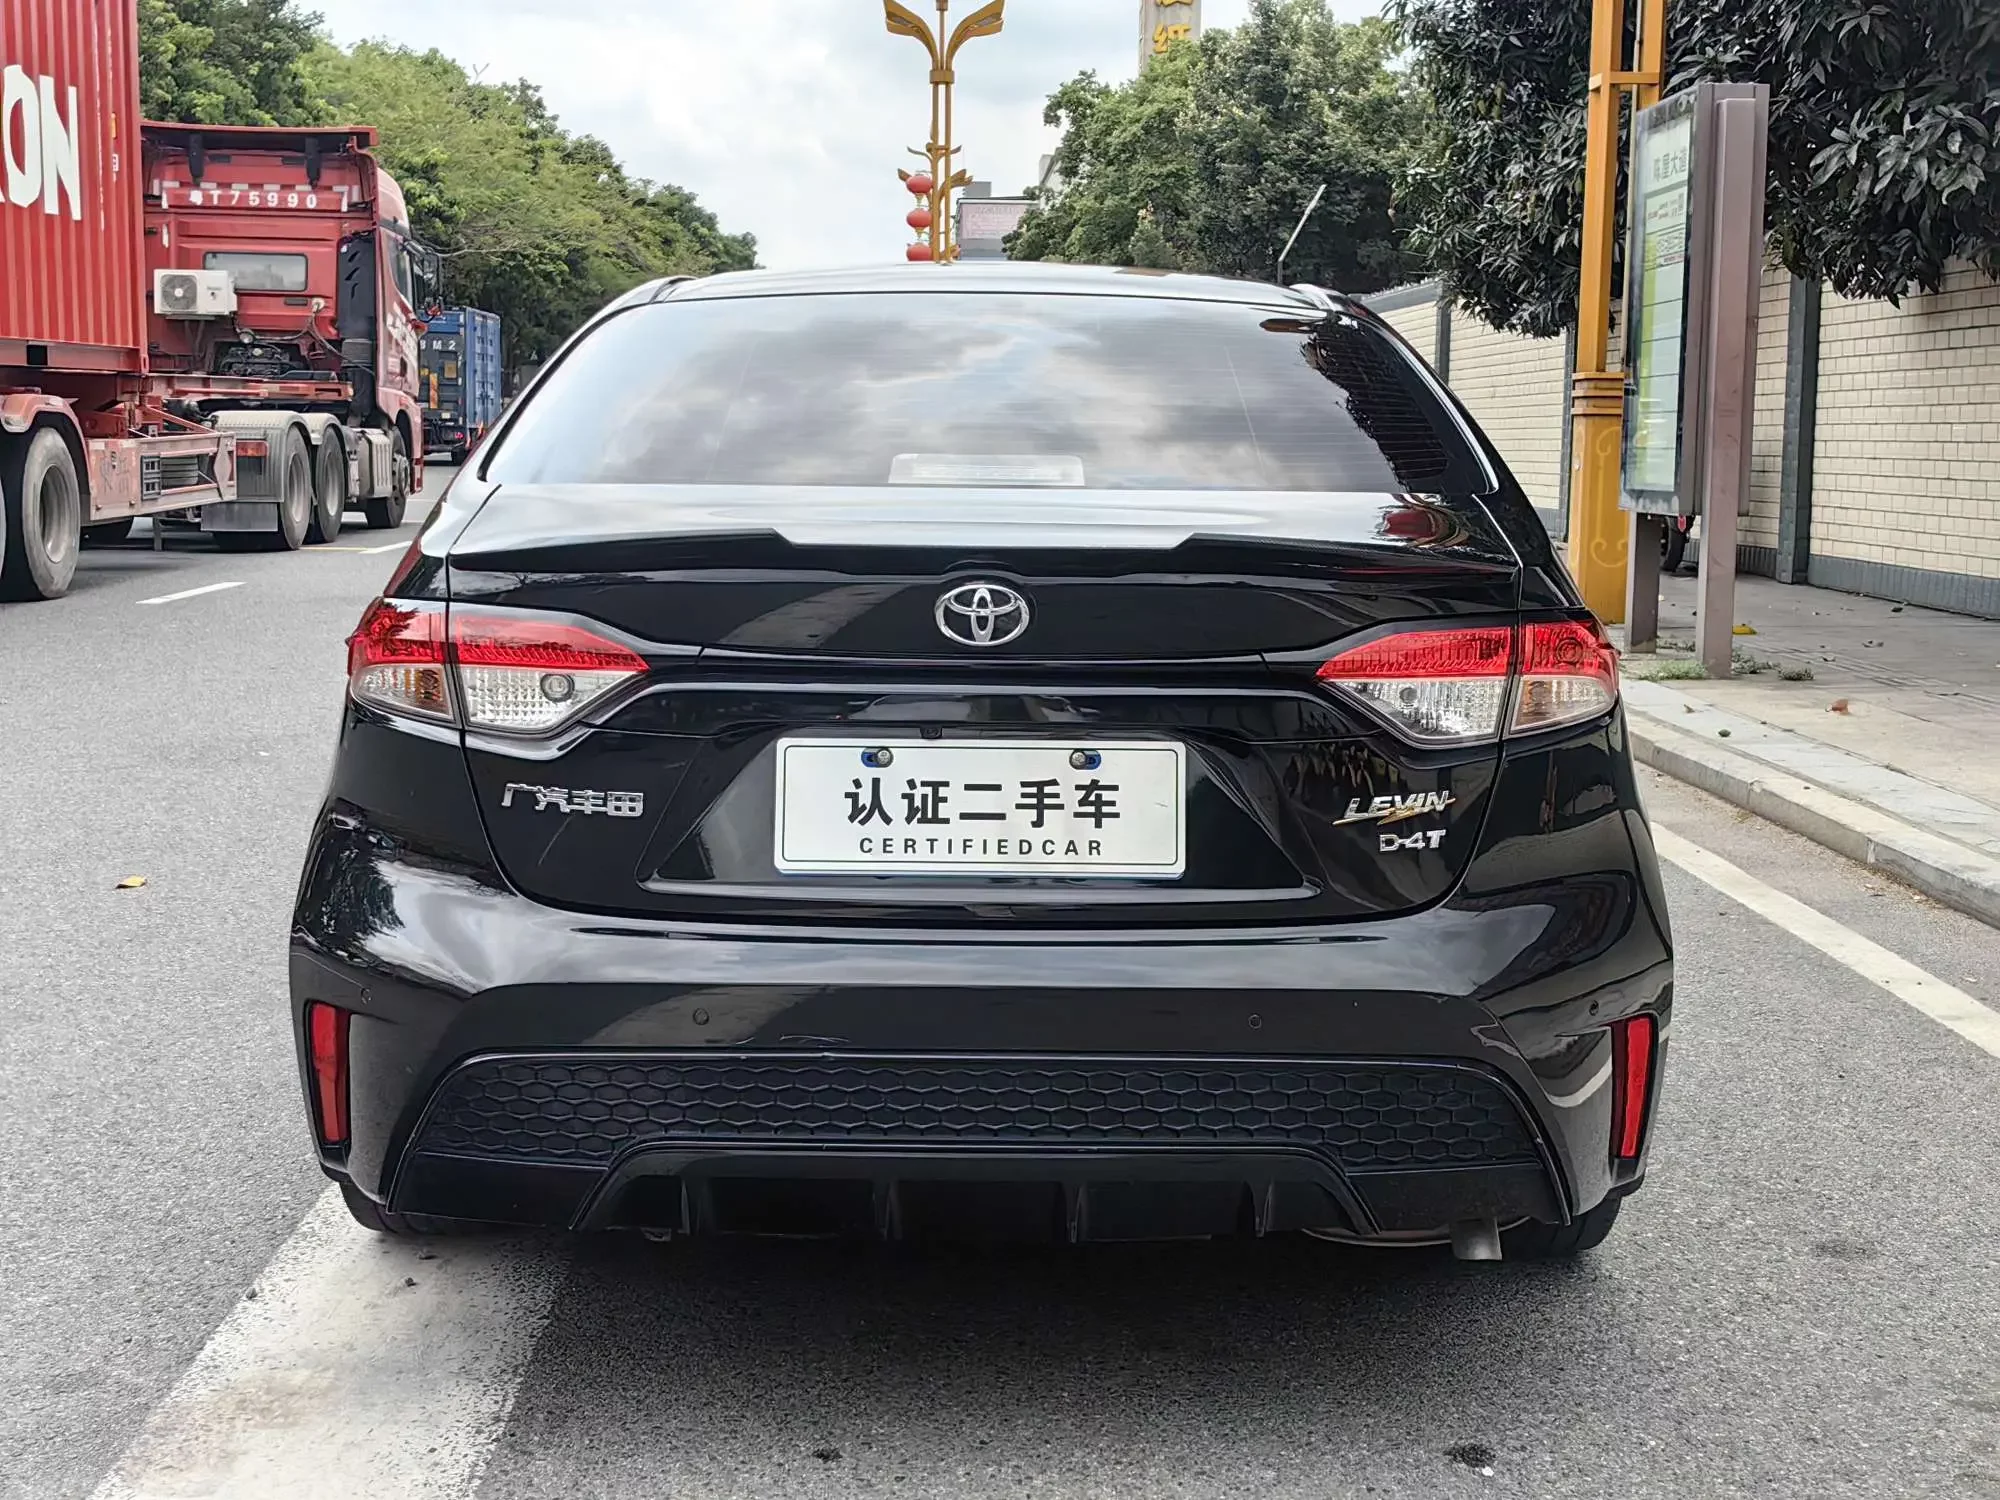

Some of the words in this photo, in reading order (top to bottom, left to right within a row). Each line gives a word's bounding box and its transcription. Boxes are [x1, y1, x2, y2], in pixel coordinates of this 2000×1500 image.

[0, 64, 82, 221] ON
[501, 783, 644, 817] 广汽丰田
[844, 777, 1121, 829] 认证二手车
[1343, 790, 1450, 819] LEVIN
[859, 837, 1102, 856] CERTIFIEDCAR
[1379, 829, 1447, 852] D-4T
